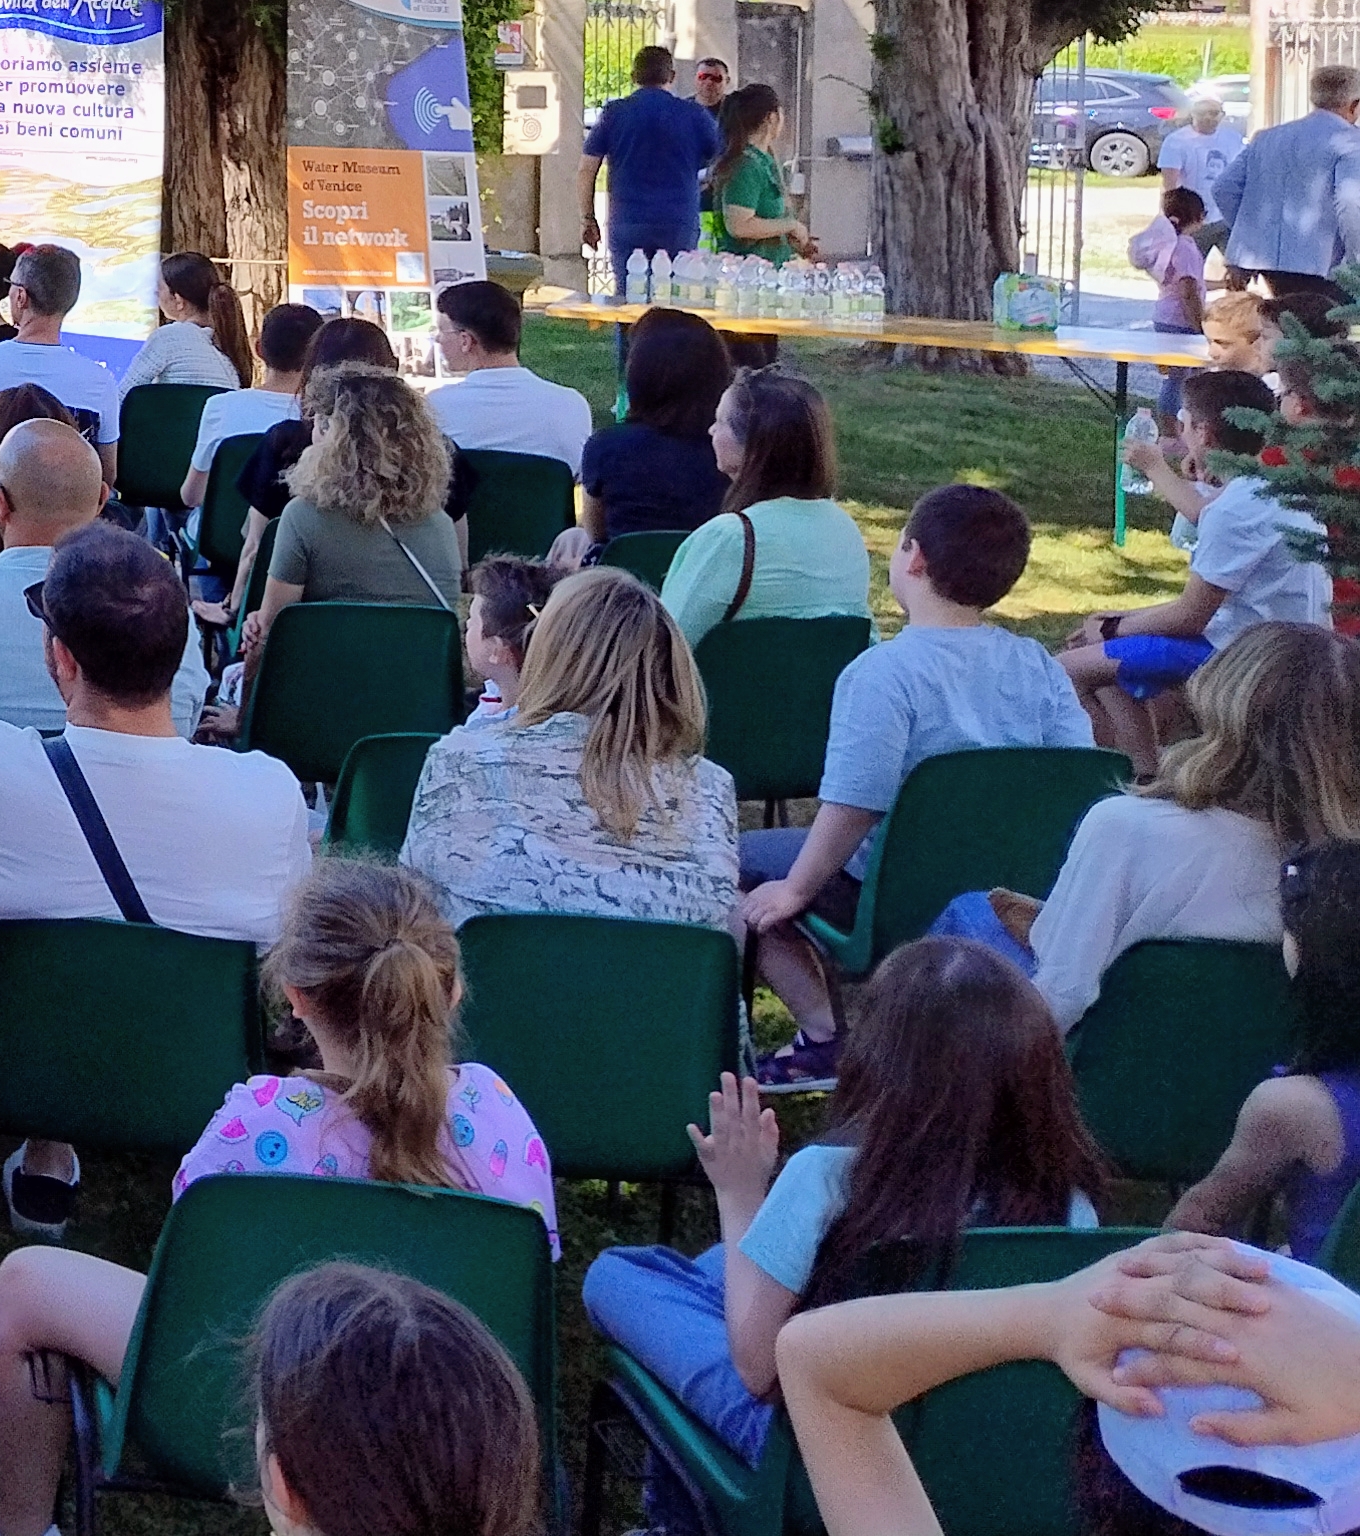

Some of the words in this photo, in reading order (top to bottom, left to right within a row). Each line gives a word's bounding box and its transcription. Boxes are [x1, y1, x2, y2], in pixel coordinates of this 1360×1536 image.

[68, 57, 143, 75] assieme
[19, 80, 126, 97] promuovere
[13, 102, 66, 116] nuova
[72, 103, 135, 119] cultura
[16, 121, 54, 138] beni
[59, 125, 123, 141] comuni
[302, 159, 339, 173] Water
[342, 161, 401, 175] Museum
[302, 180, 314, 191] of
[316, 179, 362, 193] Venice
[302, 199, 369, 224] Scopri
[302, 225, 319, 245] il
[322, 227, 409, 247] network
